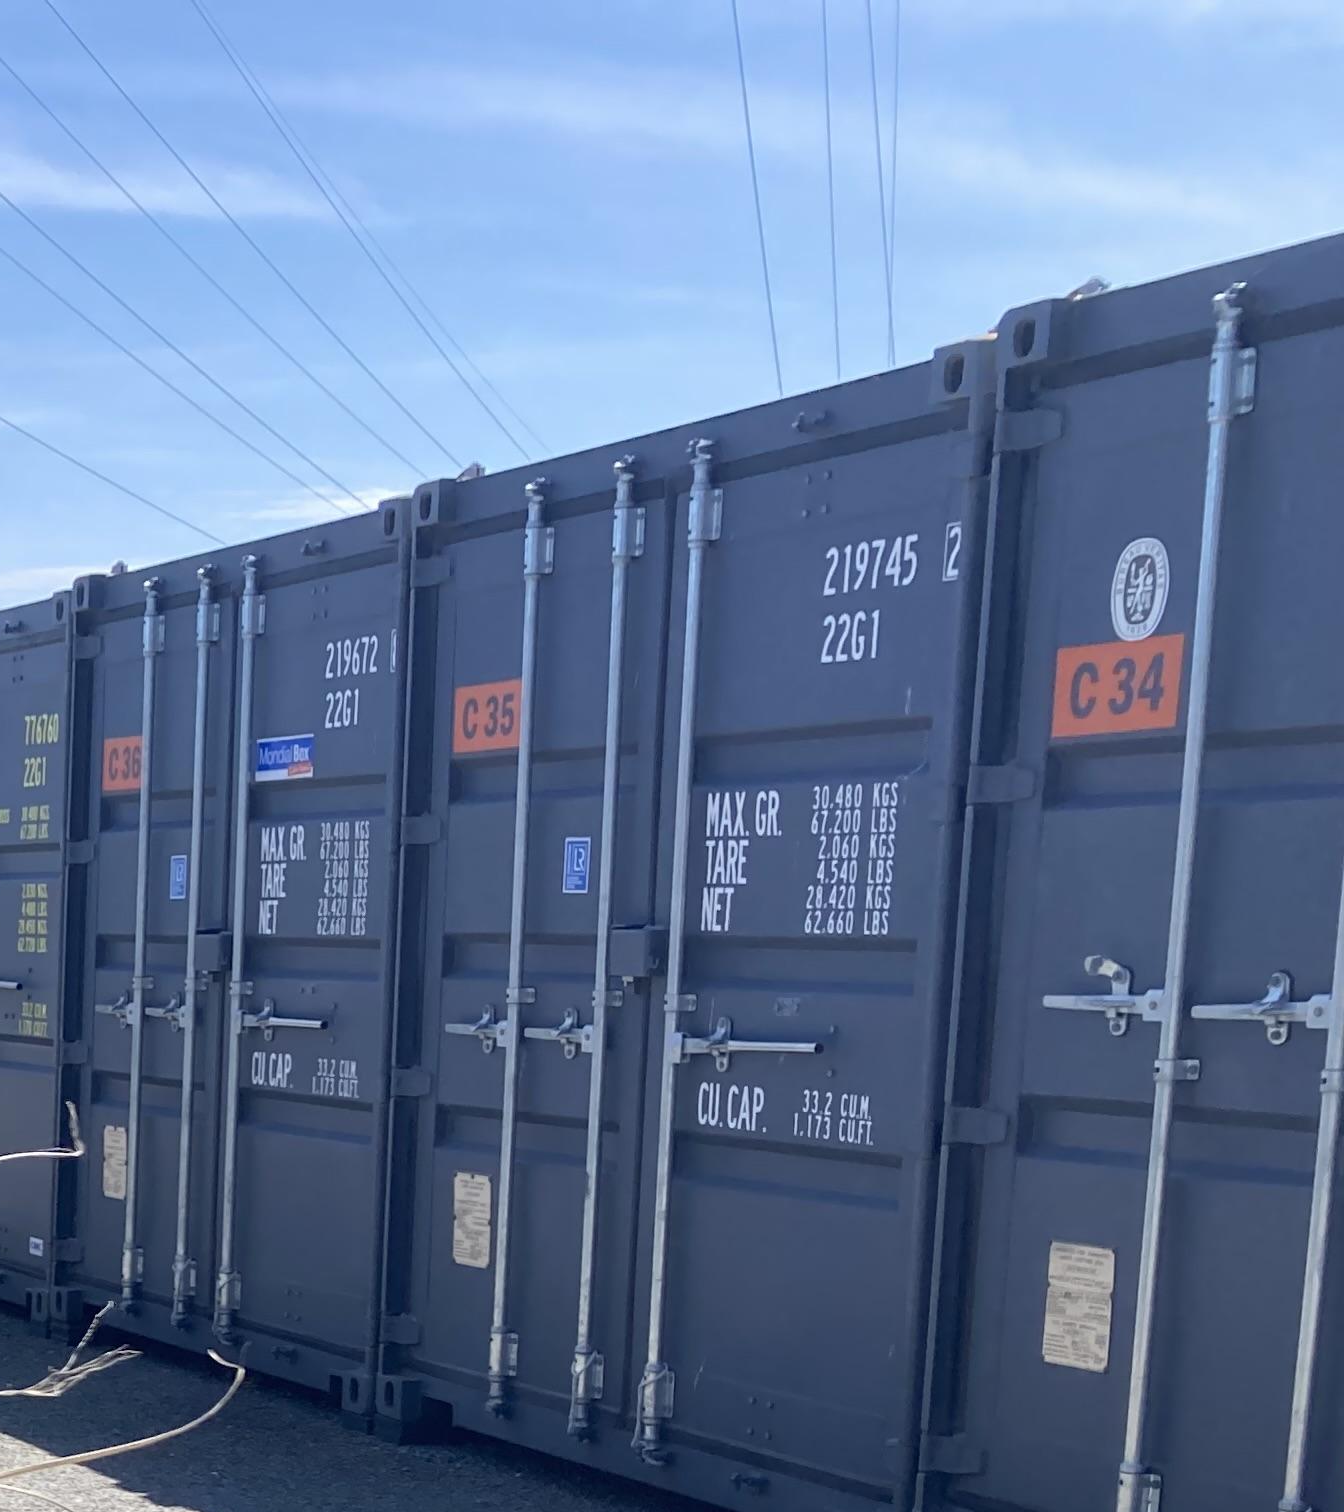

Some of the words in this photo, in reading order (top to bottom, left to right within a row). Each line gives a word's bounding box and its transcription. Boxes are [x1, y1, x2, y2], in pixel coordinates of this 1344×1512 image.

[823, 533, 918, 596] 219745
[820, 610, 880, 663] 22G1
[325, 635, 378, 679] 219672
[1070, 662, 1100, 719] C
[1108, 652, 1165, 715] 34
[325, 688, 359, 728] 22G1
[462, 697, 478, 739] C
[483, 693, 514, 737] 35
[24, 713, 59, 745] 776760
[24, 757, 46, 787] 22G1
[812, 784, 862, 809] 30.480
[872, 782, 898, 807] KGS
[706, 792, 749, 837] MAX.
[755, 790, 782, 836] GR.
[811, 809, 861, 834] 67.200
[871, 808, 897, 833] LBS
[261, 827, 287, 862] MAX.
[290, 825, 307, 860] GR.
[355, 820, 369, 840] KGS
[354, 840, 369, 859] LBS
[818, 834, 859, 859] 2.060
[869, 834, 895, 858] KGS
[353, 860, 368, 878] KGS
[706, 840, 749, 884] TARE
[816, 860, 857, 884] 4.540
[867, 860, 893, 884] LBS
[261, 863, 287, 898] TARE
[352, 879, 368, 897] LBS
[352, 898, 366, 916] KGS
[701, 887, 734, 932] NET
[806, 885, 855, 909] 28.420
[865, 885, 891, 909] KGS
[259, 900, 278, 934] NET
[350, 917, 366, 936] LBS
[804, 910, 854, 934] 62.660
[863, 910, 889, 935] LBS
[803, 1089, 833, 1116] 33.2
[793, 1112, 830, 1140] 1.173
